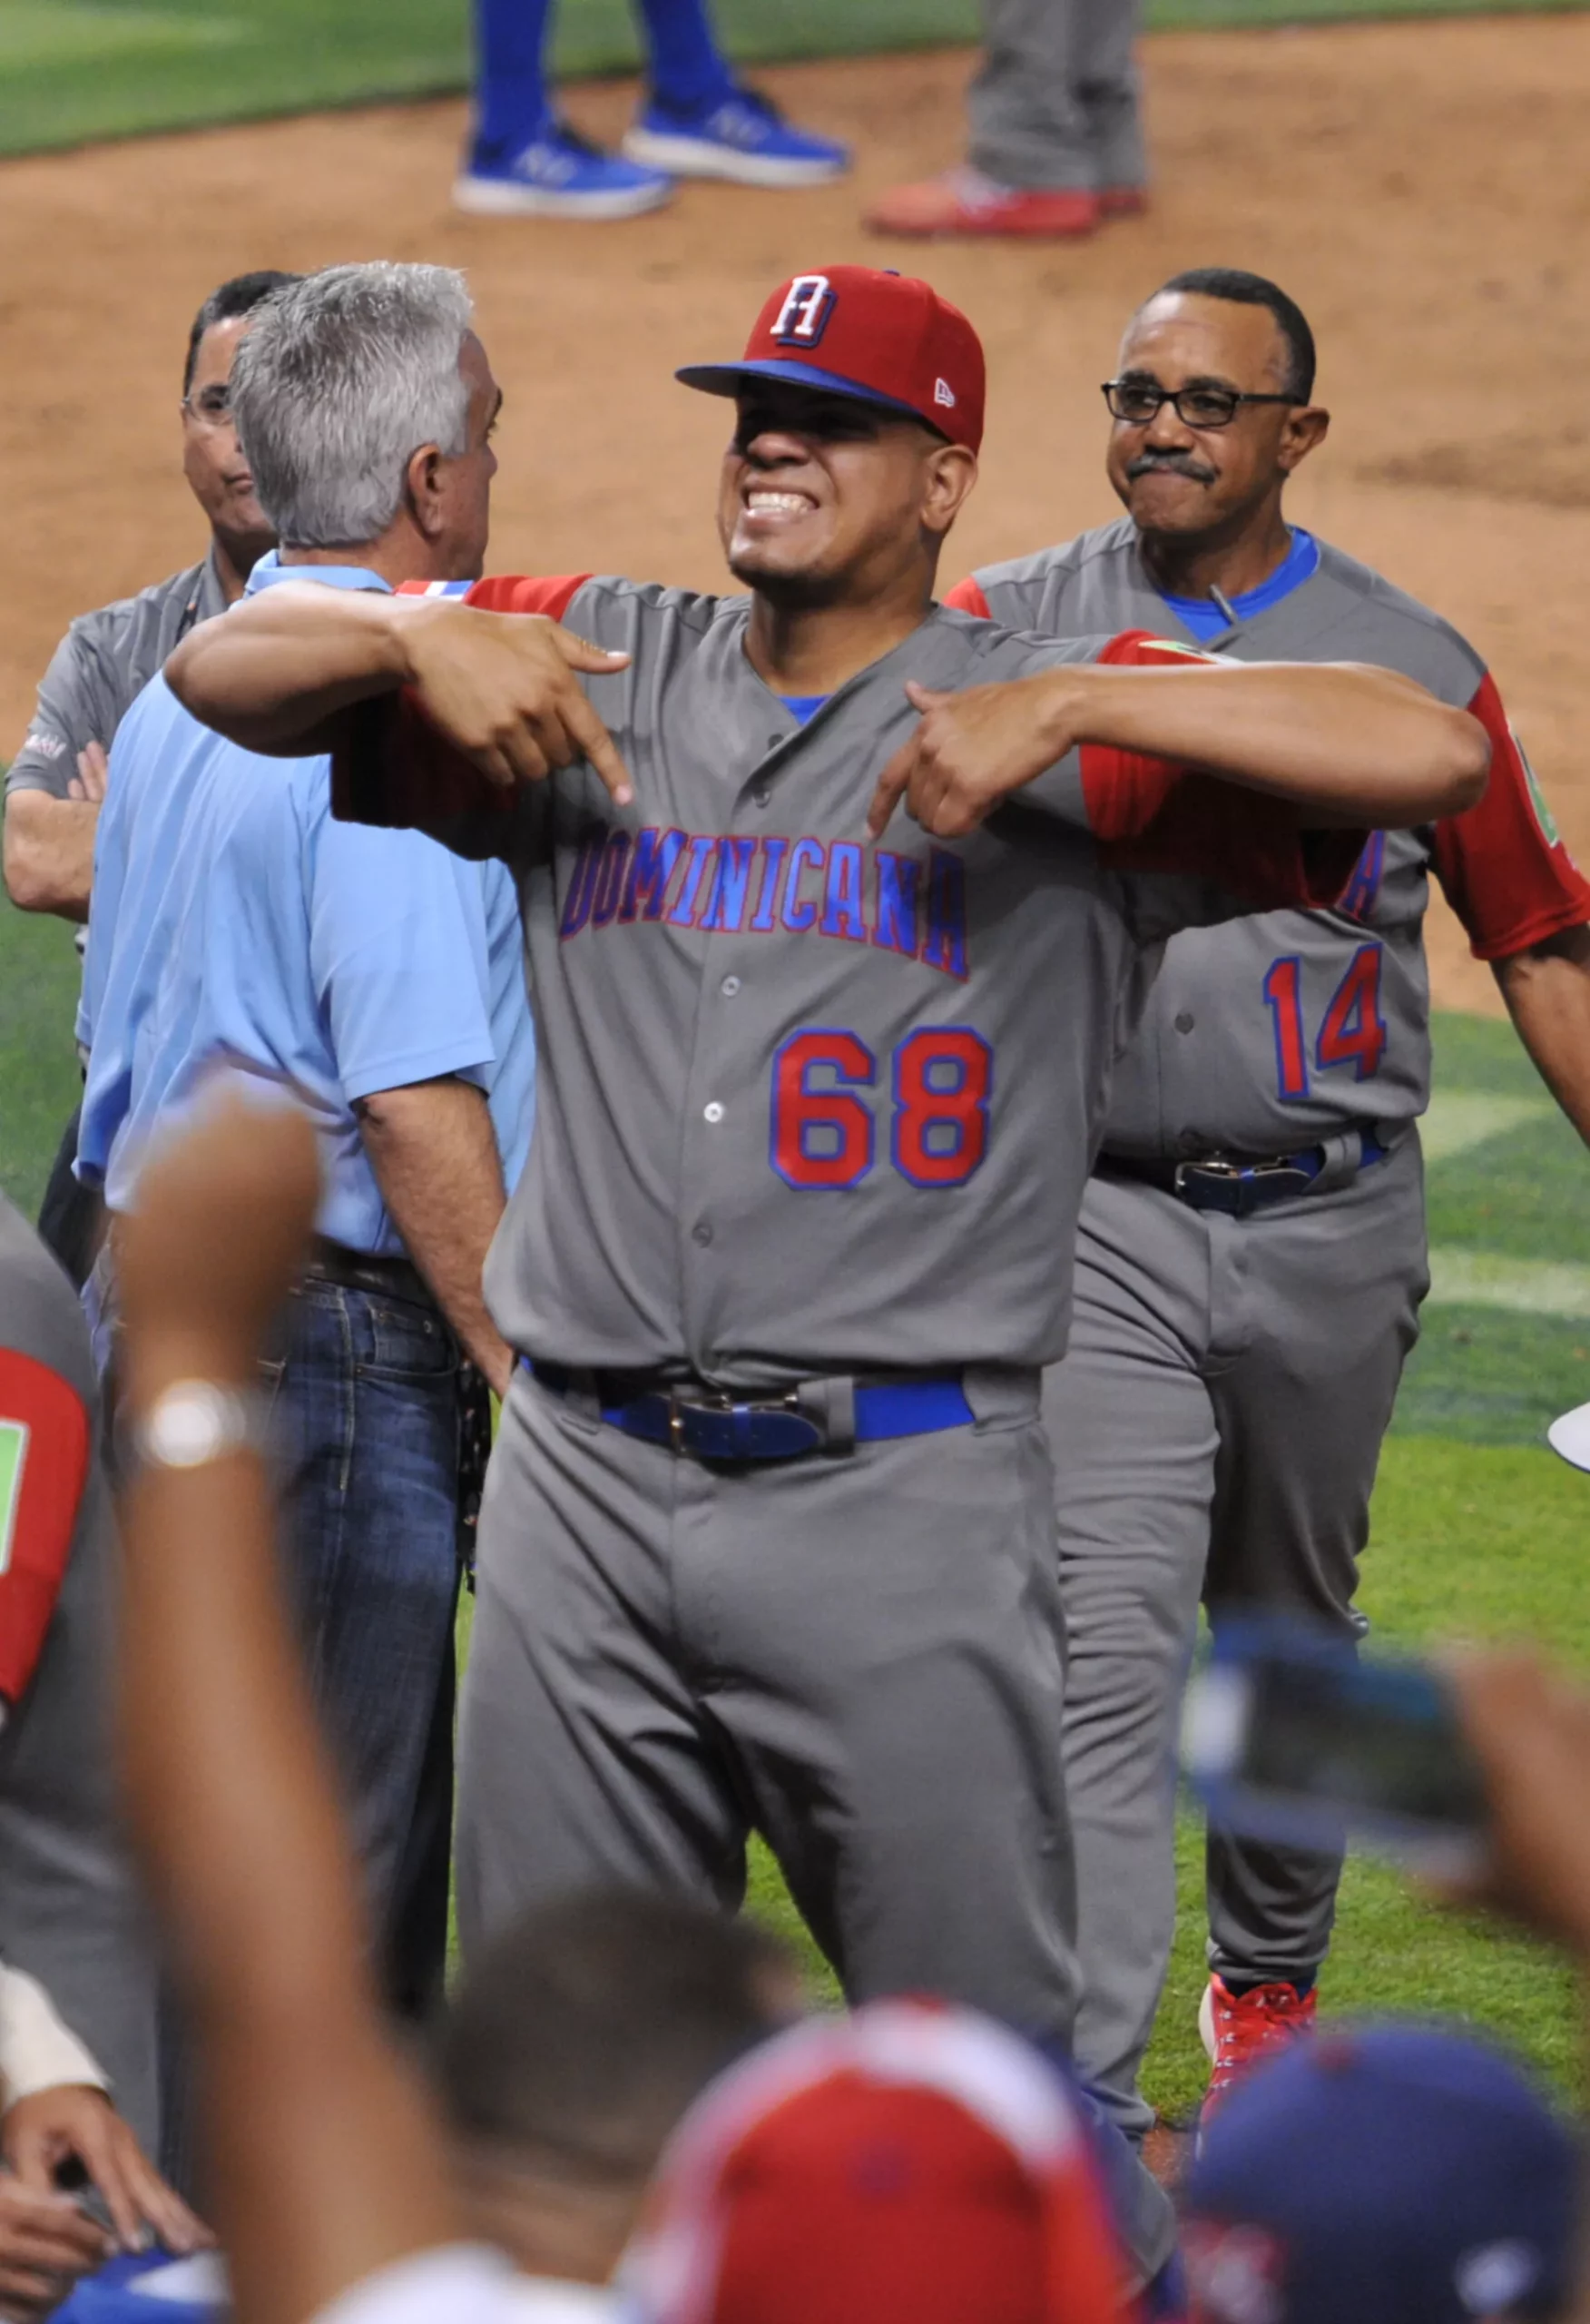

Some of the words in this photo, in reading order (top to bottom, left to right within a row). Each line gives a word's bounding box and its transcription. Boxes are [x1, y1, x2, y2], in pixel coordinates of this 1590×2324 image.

[560, 827, 969, 983] DOMINICANA
[1262, 941, 1387, 1100] 14
[769, 1026, 993, 1191] 68
